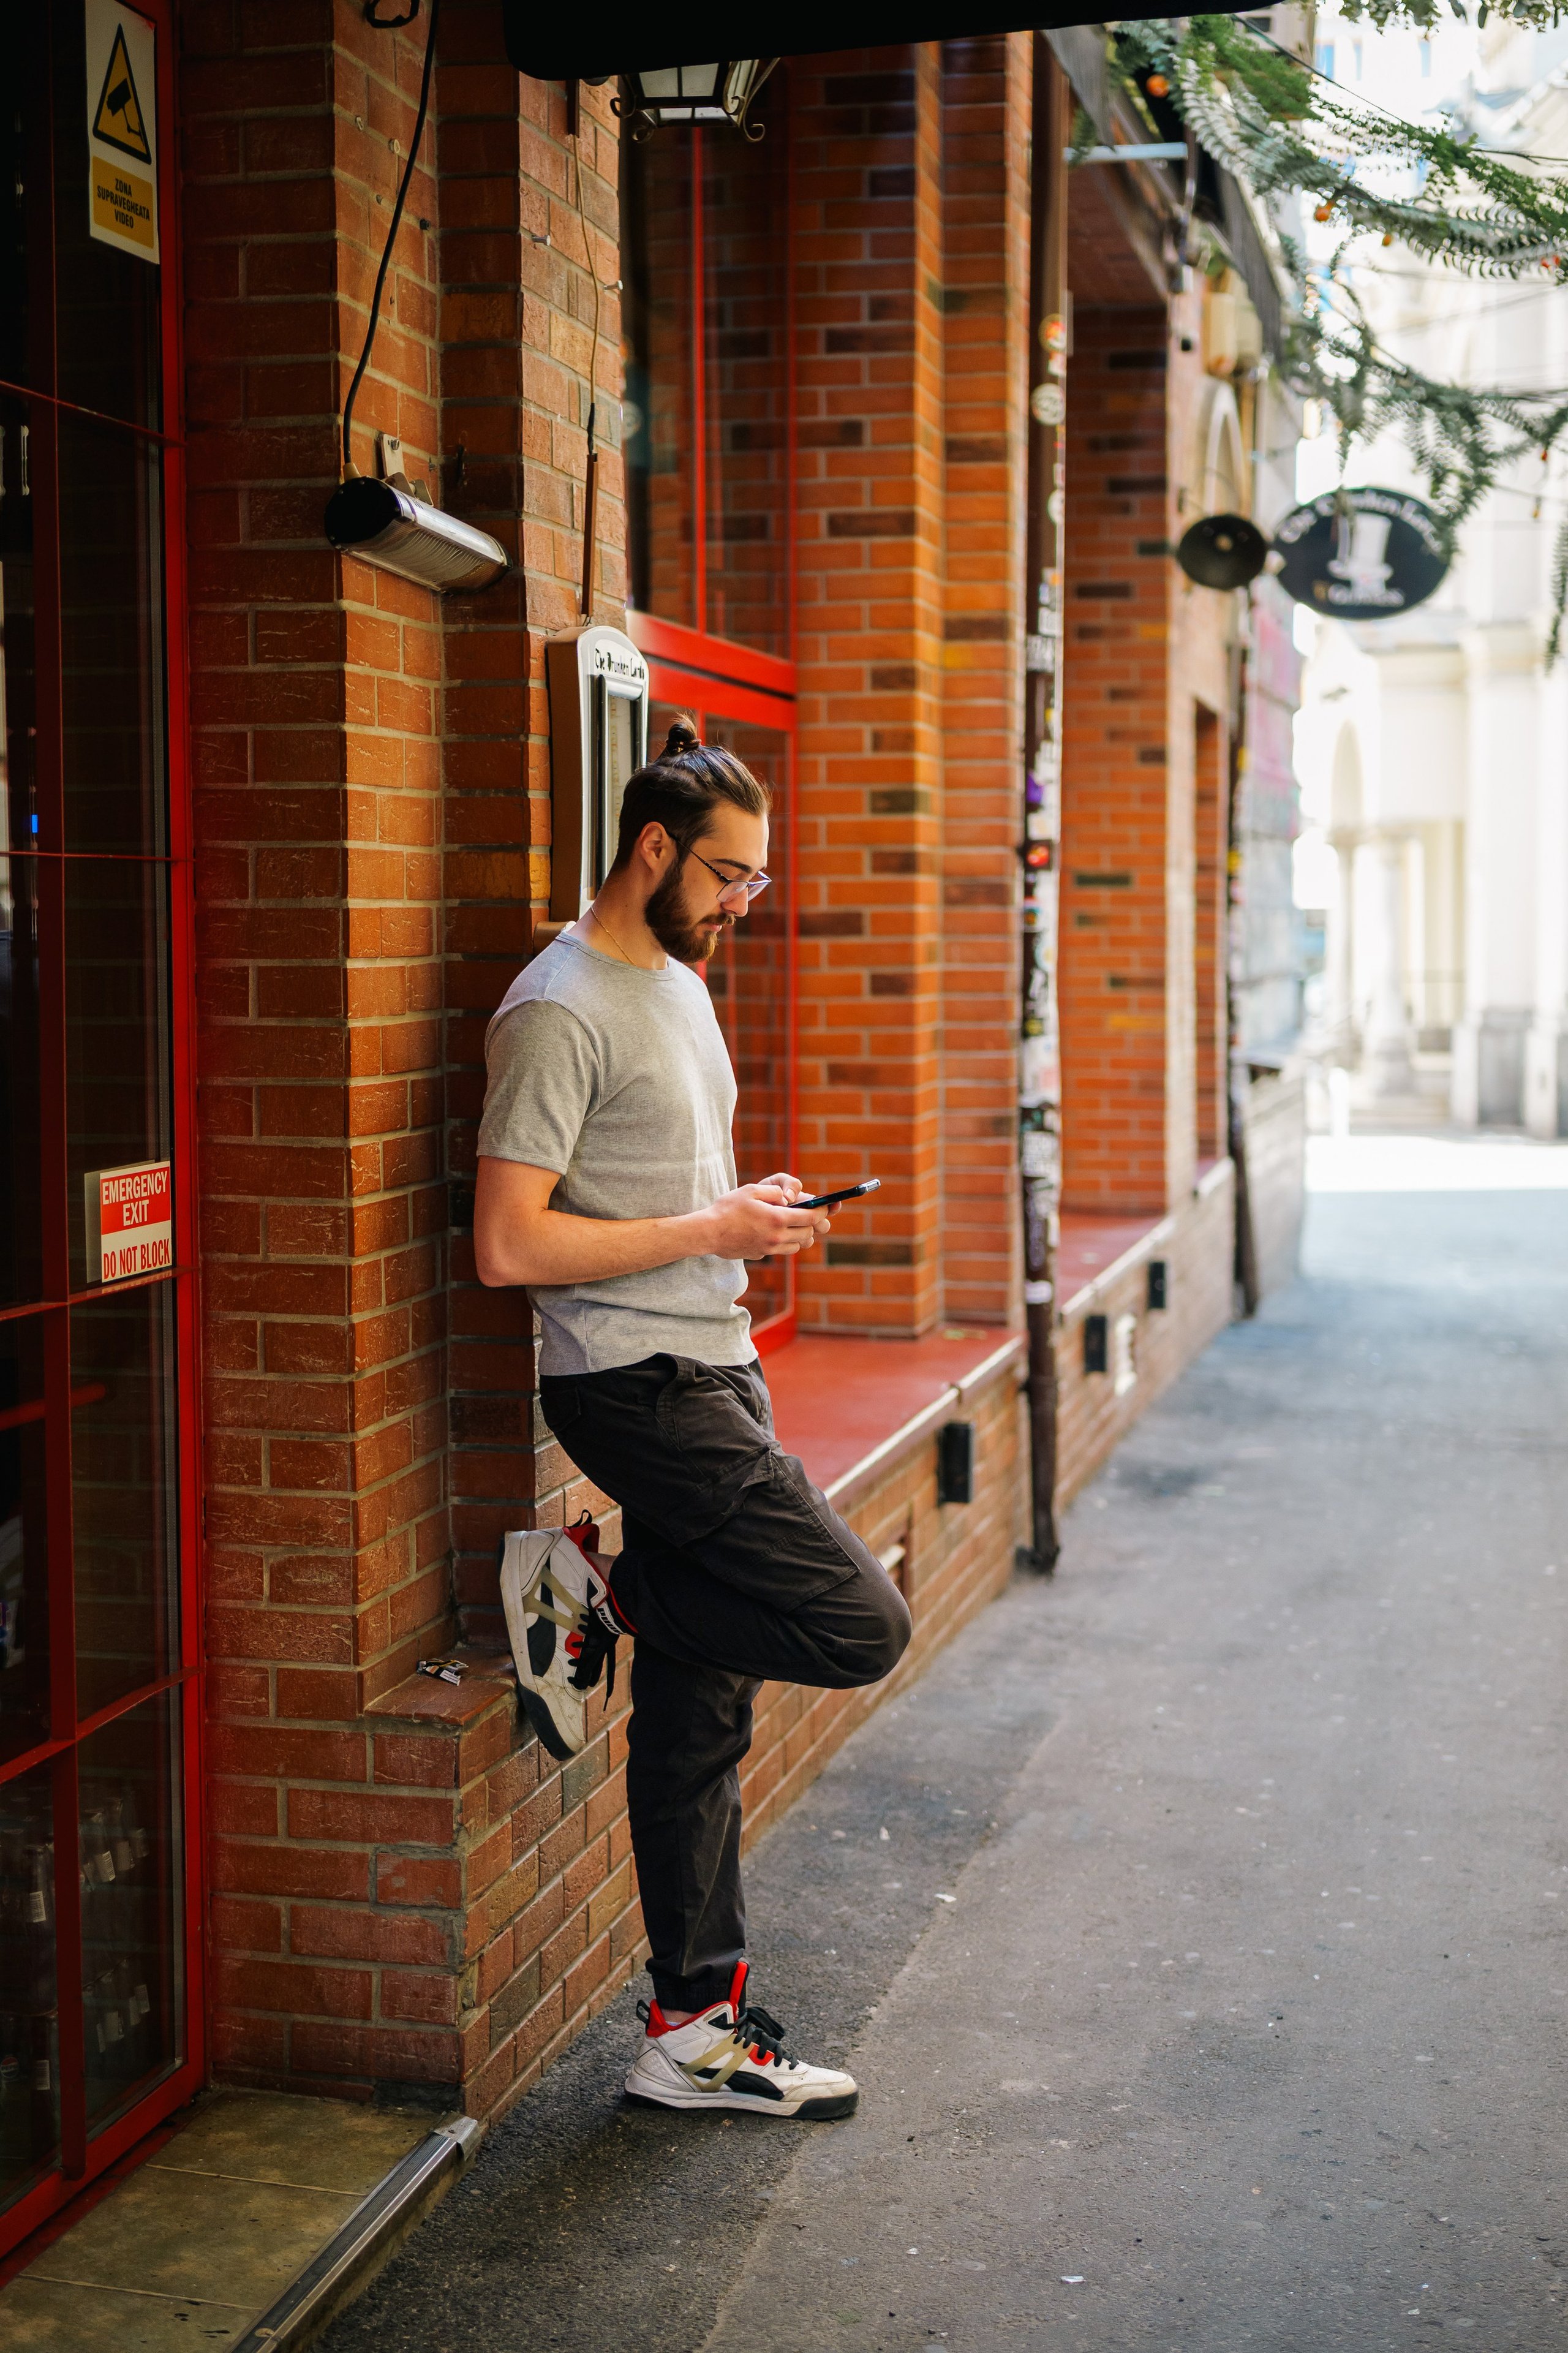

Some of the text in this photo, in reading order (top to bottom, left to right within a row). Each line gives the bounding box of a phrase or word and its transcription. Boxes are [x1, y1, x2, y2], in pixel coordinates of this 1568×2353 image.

[115, 178, 132, 197] ZONA
[97, 185, 150, 221] SUPRAVEGHEATA
[115, 209, 134, 229] VIDEO
[102, 1171, 167, 1205] EMERGENCY
[123, 1199, 149, 1226] EXIT
[104, 1238, 170, 1279] DO NOT BLOCK
